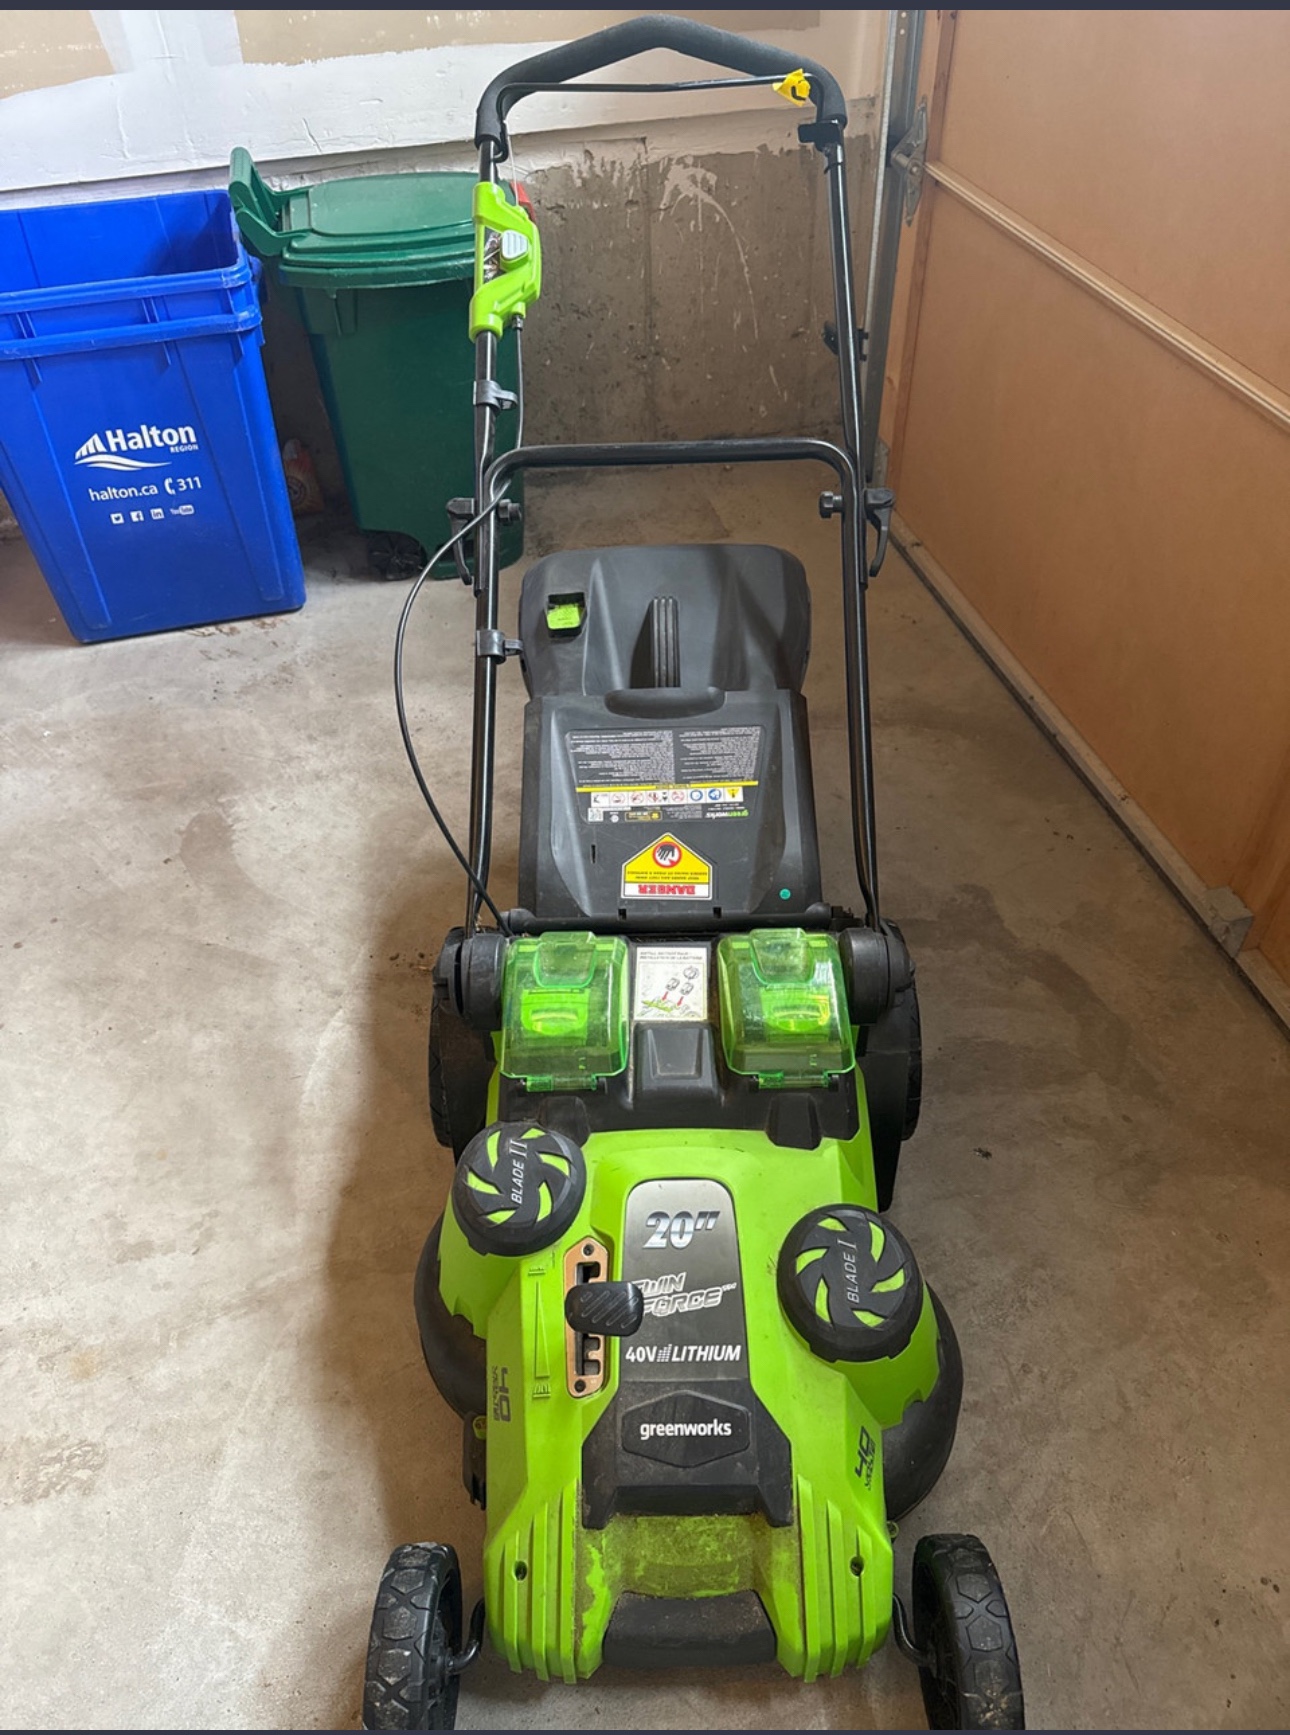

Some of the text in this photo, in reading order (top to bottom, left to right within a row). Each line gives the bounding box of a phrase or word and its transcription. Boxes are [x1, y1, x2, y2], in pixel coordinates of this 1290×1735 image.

[105, 424, 197, 453] Halton
[170, 444, 199, 454] REGION
[88, 476, 202, 502] halton.ca 311
[638, 883, 696, 896] DANGER
[511, 1158, 525, 1205] BLADE
[843, 1251, 860, 1304] BLADE
[625, 1344, 742, 1363] 40V LITHIUM
[640, 1417, 732, 1440] greenworks
